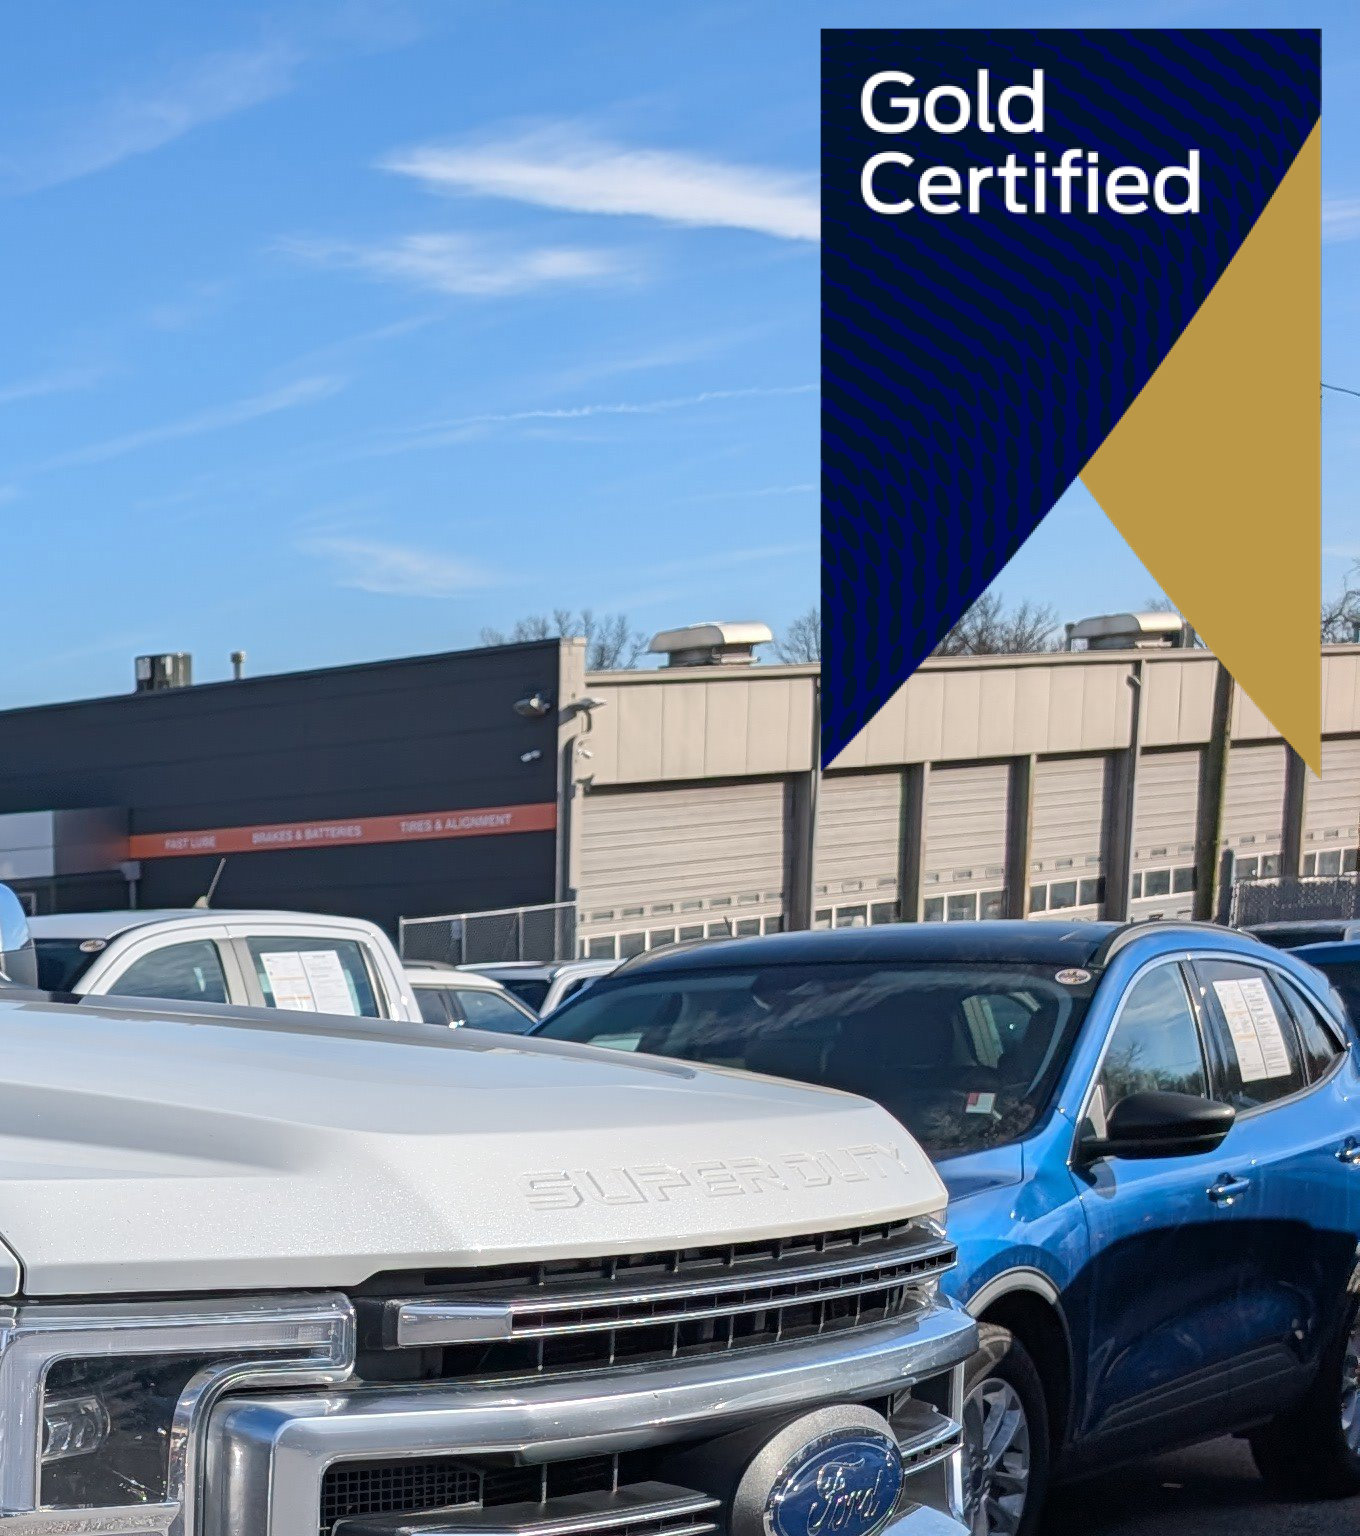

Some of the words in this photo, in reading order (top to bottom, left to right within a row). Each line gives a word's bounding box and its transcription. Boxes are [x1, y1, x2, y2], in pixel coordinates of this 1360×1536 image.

[164, 837, 189, 850] FAST
[251, 829, 294, 845] BRAKES
[295, 829, 303, 841] &
[304, 825, 363, 841] BATTERIES
[399, 820, 431, 833] TIRES
[434, 819, 443, 831] &
[444, 813, 513, 830] ALIGNMENT
[522, 1156, 789, 1211] SUPER
[783, 1142, 912, 1187] DUTY
